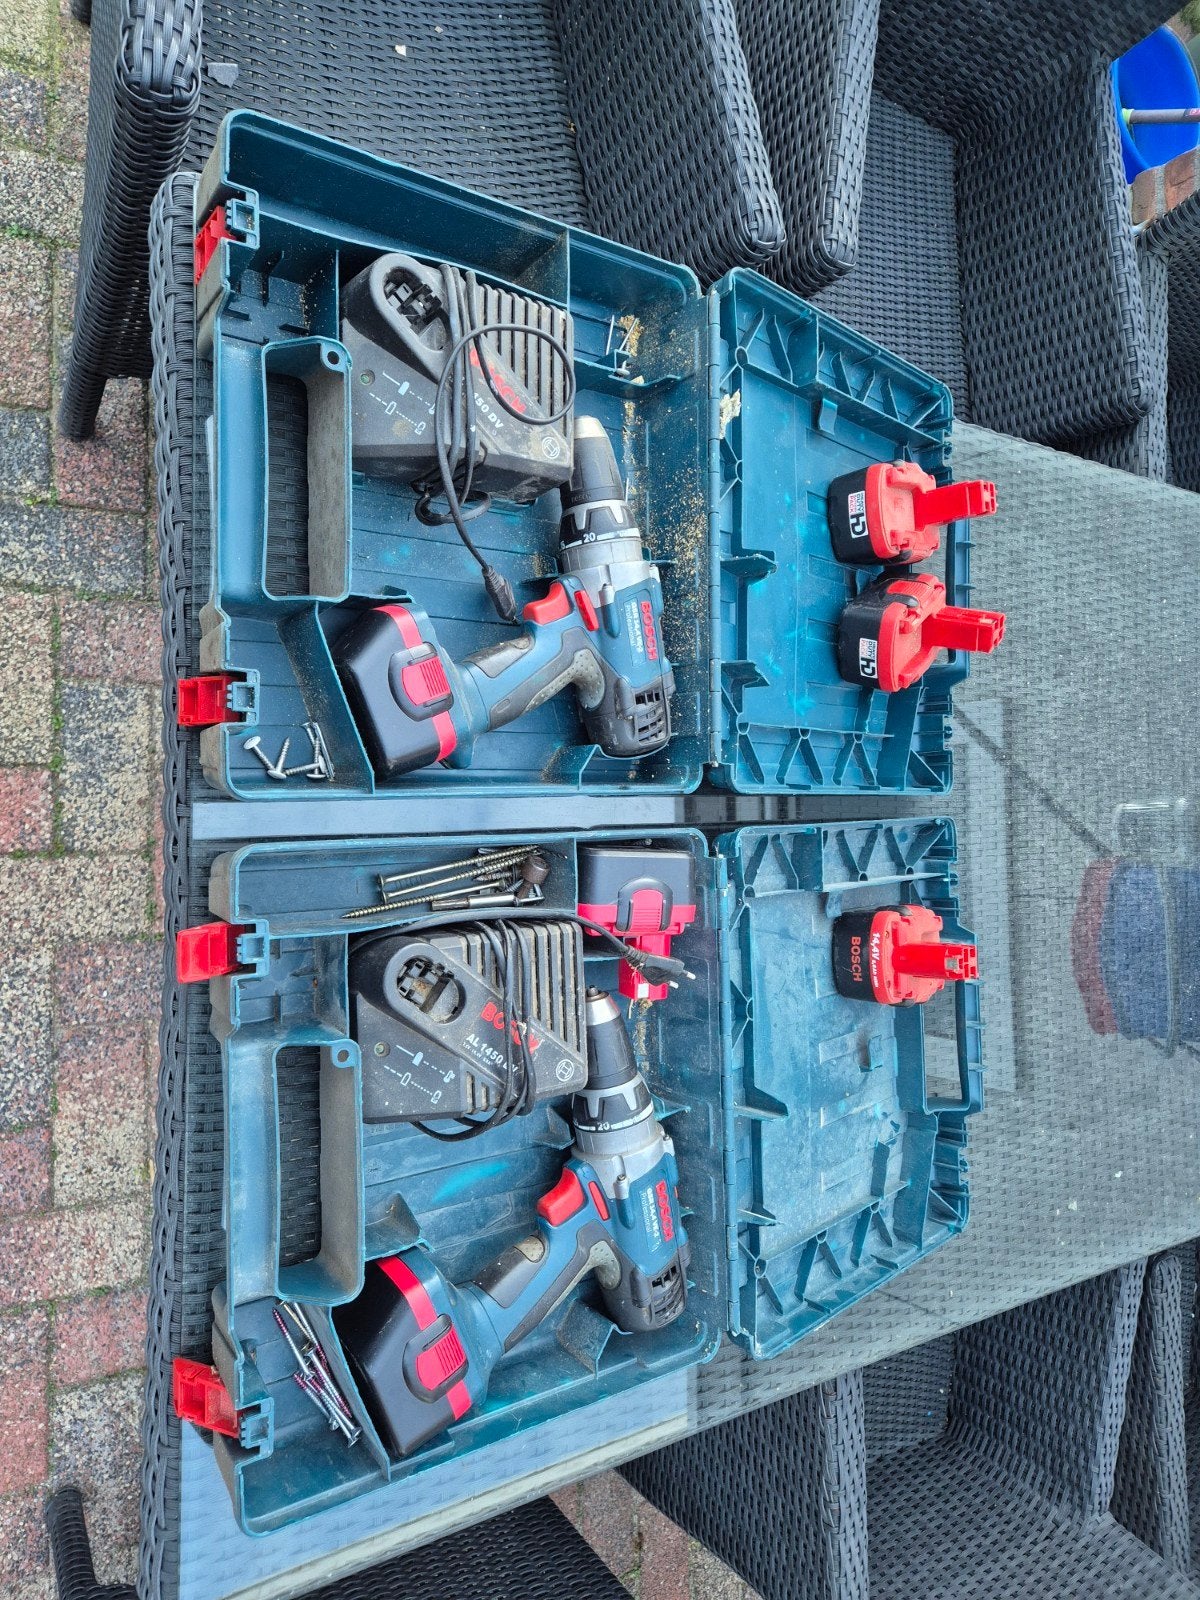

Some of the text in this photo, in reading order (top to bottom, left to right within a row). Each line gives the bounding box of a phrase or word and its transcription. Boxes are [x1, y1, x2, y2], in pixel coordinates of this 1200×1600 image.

[487, 411, 504, 428] DV
[850, 513, 866, 535] HD
[583, 532, 596, 543] 20
[640, 601, 658, 660] BOSCH
[861, 657, 875, 676] HD
[870, 932, 880, 960] 14,4V
[851, 936, 862, 982] BOSCH
[466, 1034, 479, 1048] AL
[480, 1043, 505, 1065] 1450
[597, 1121, 610, 1131] 20
[655, 1180, 675, 1242] BOSCH
